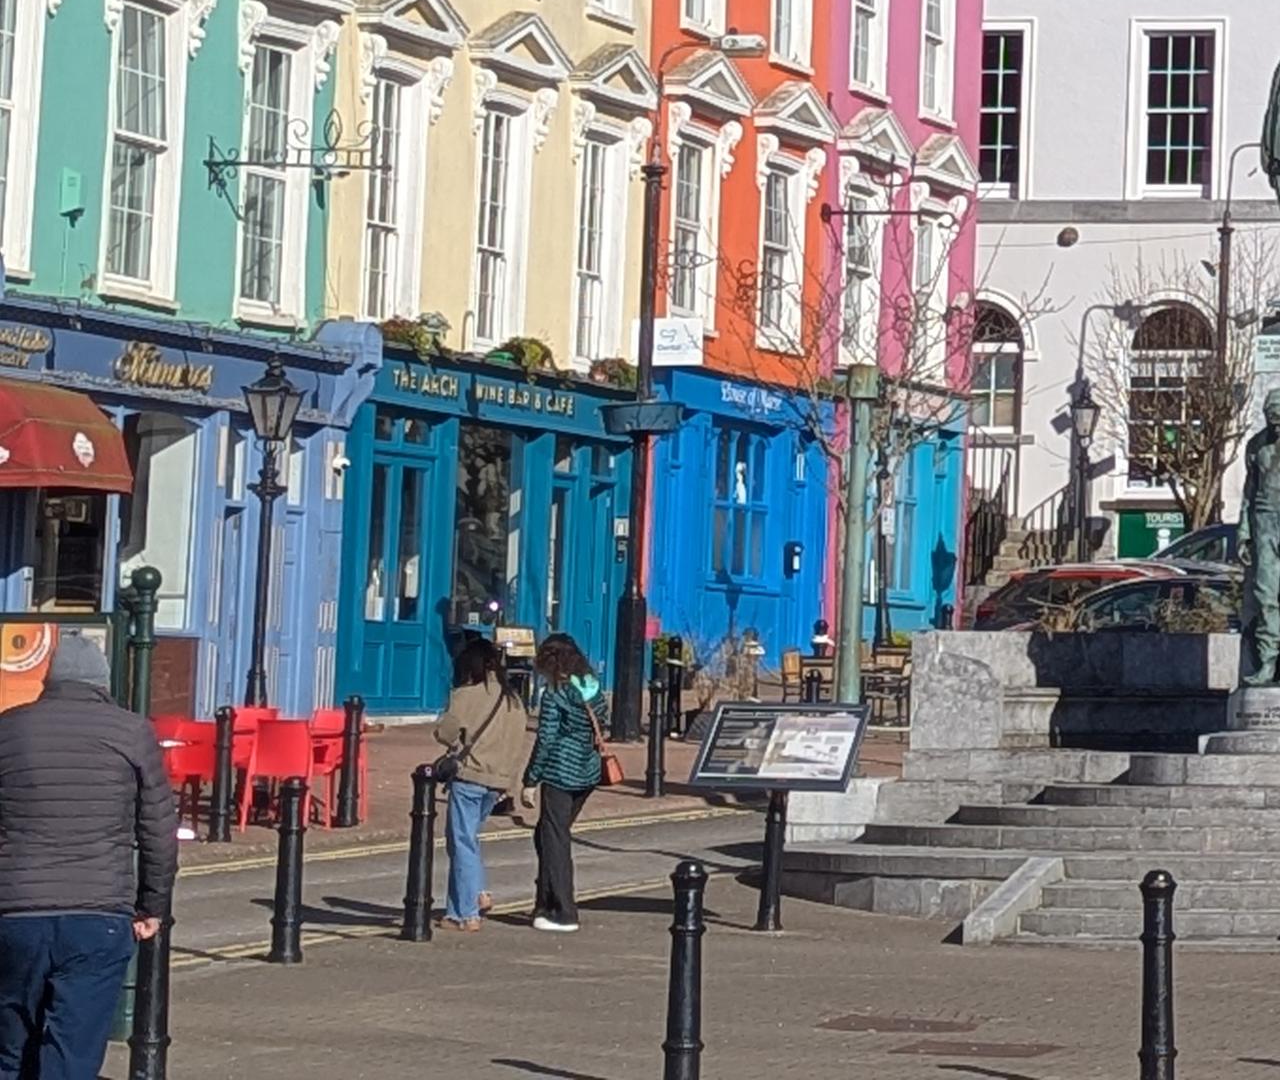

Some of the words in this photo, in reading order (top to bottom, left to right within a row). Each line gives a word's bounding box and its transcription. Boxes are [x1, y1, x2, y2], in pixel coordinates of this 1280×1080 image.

[393, 369, 417, 389] THE
[420, 374, 459, 398] ARCH
[475, 382, 504, 404] WINE
[507, 389, 531, 406] BAR
[533, 394, 542, 409] &
